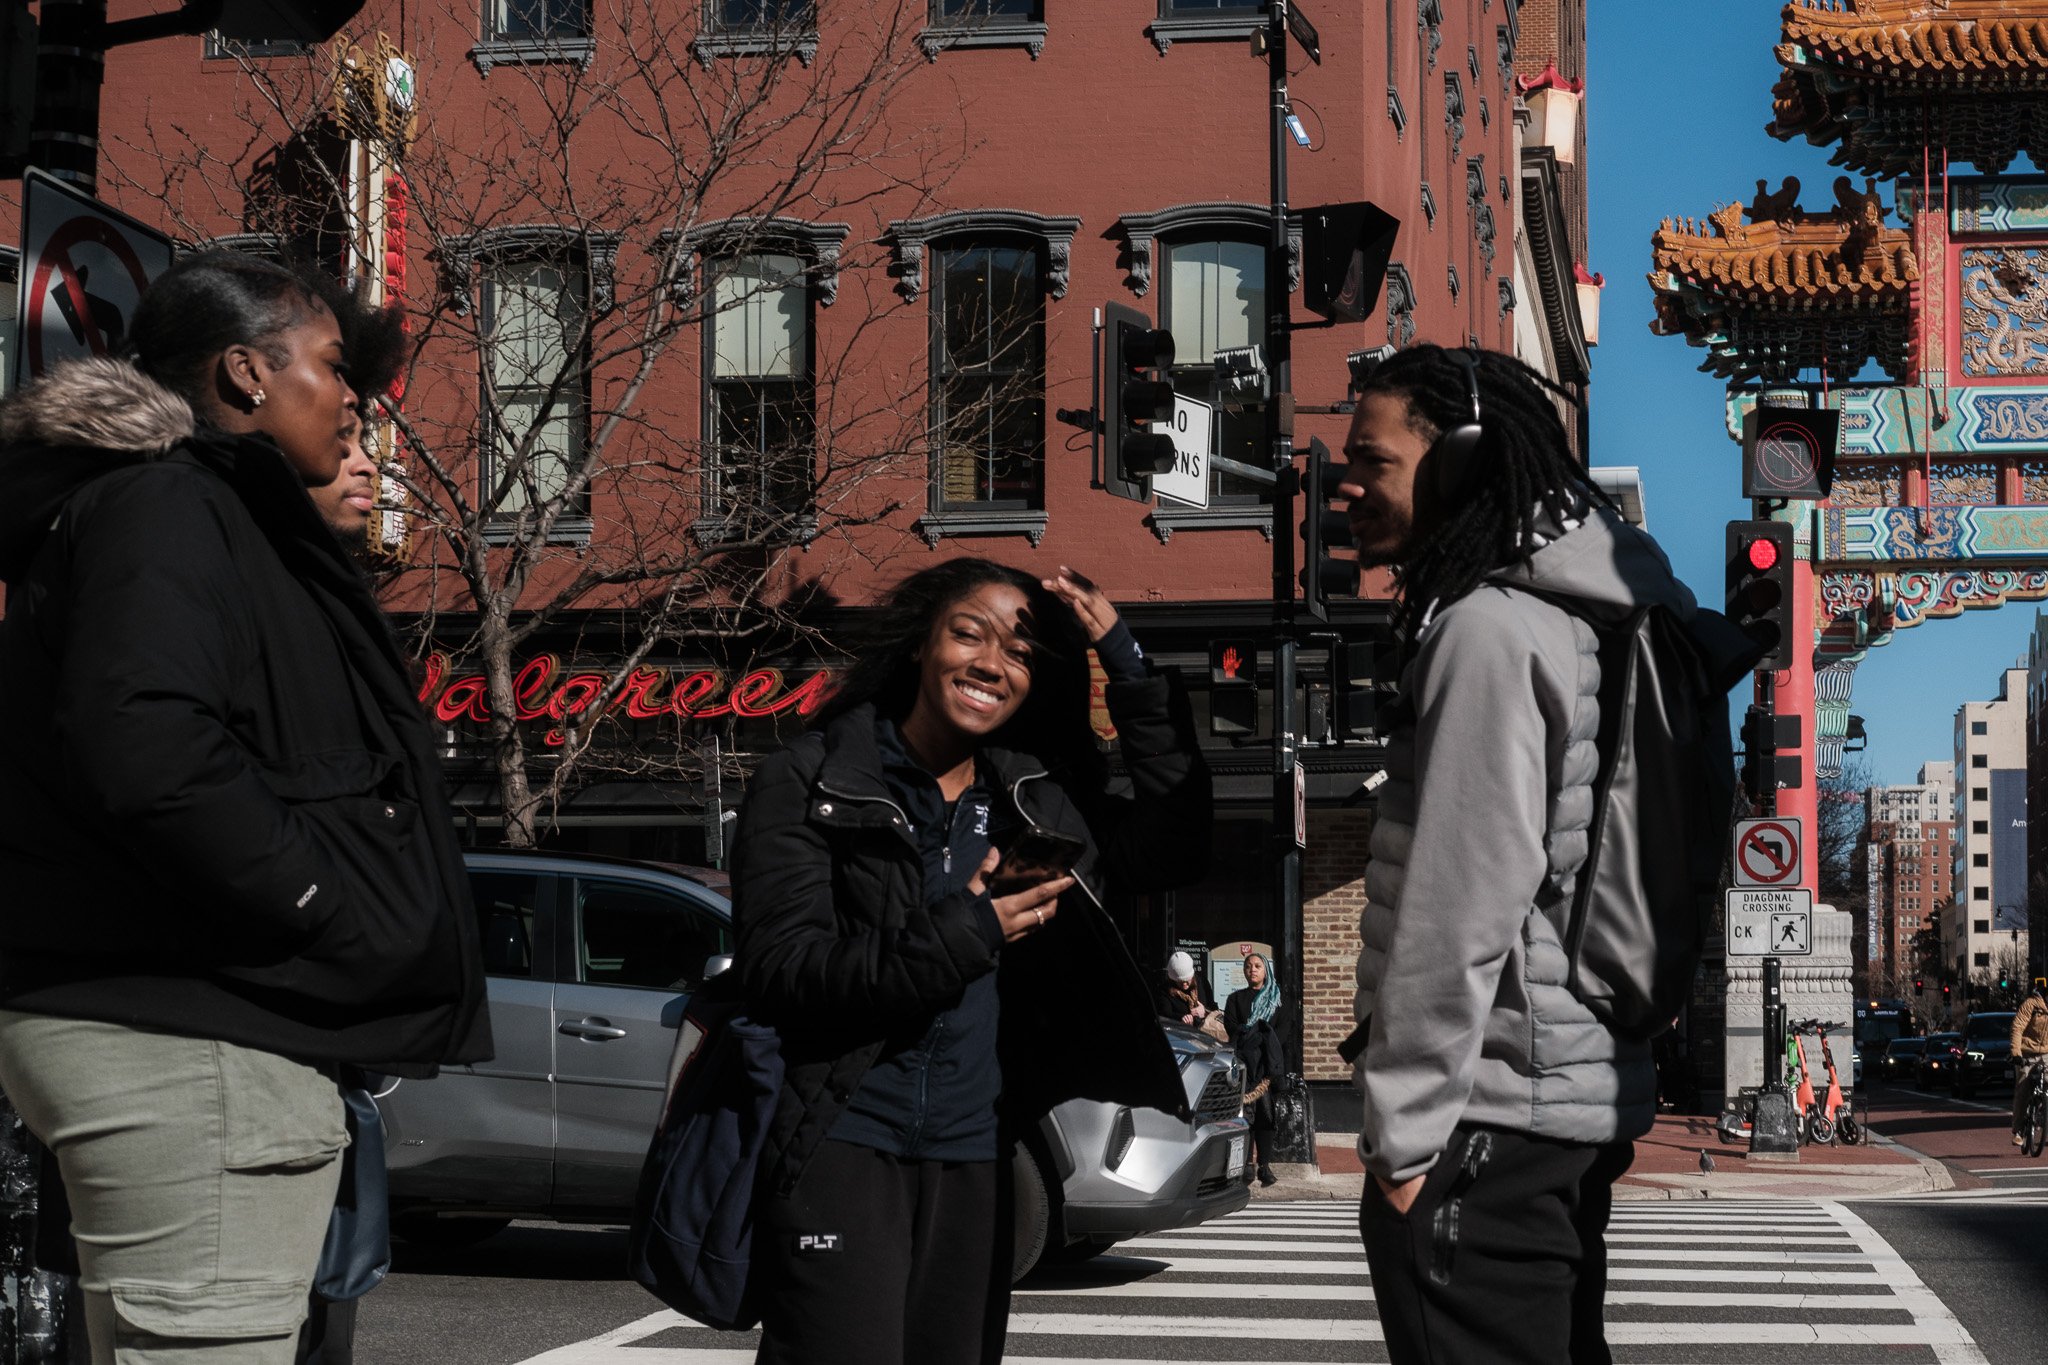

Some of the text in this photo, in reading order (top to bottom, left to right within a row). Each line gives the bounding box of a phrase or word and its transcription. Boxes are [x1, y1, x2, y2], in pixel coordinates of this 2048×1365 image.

[1174, 449, 1200, 477] RNS
[1743, 893, 1794, 902] DIAGONAL
[1742, 903, 1791, 912] CROSSING
[800, 1235, 837, 1249] PLT
